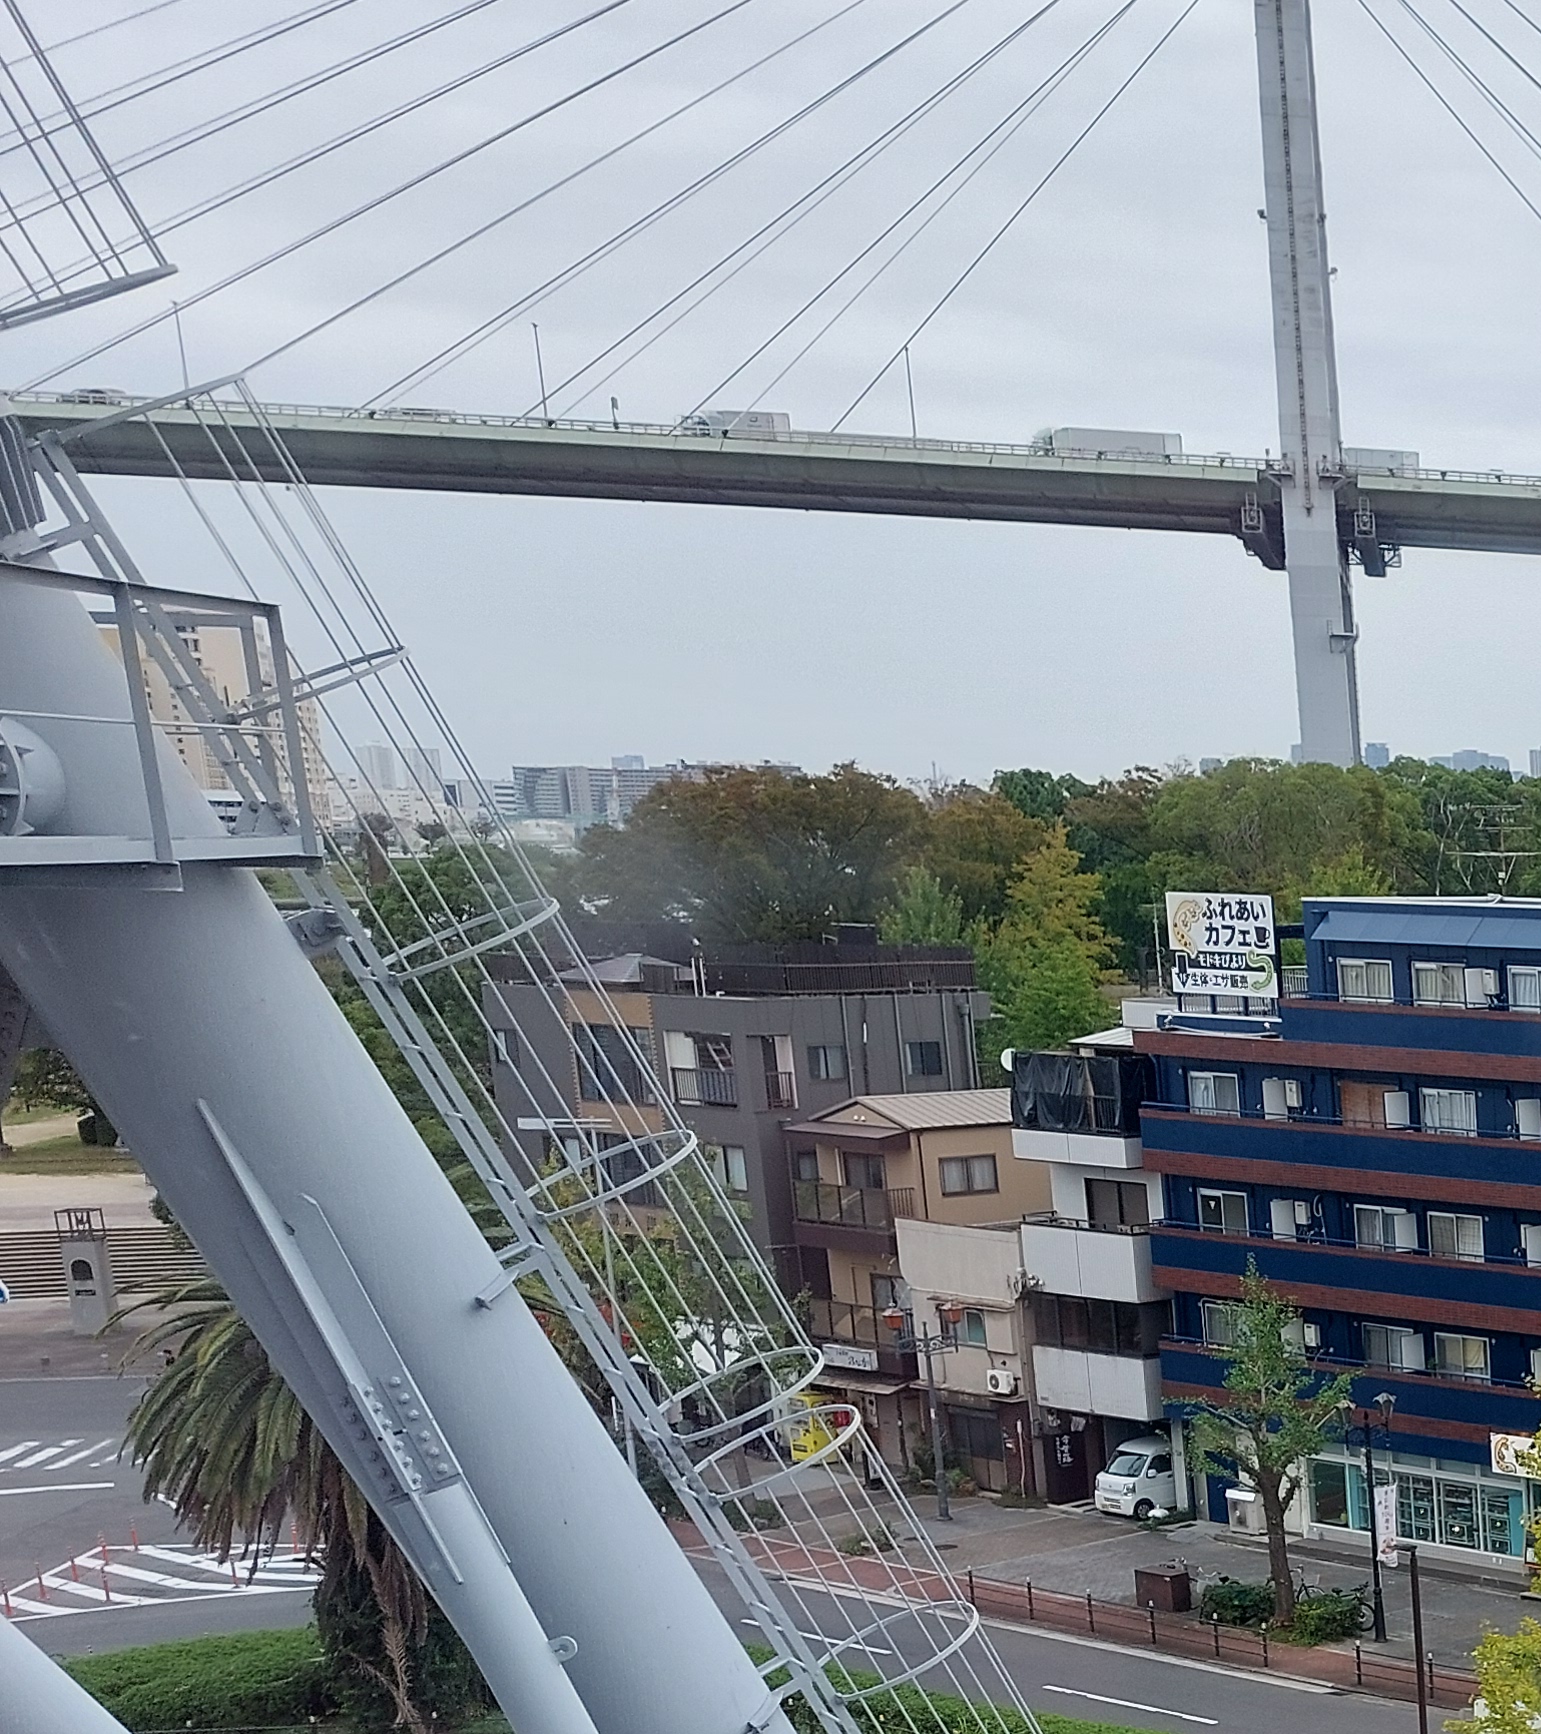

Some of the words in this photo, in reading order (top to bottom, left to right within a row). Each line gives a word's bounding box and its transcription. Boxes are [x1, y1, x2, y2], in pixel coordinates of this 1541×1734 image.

[1202, 897, 1267, 922] ふれあい
[1204, 922, 1252, 947] カフェ
[1198, 953, 1246, 969] モドキびより
